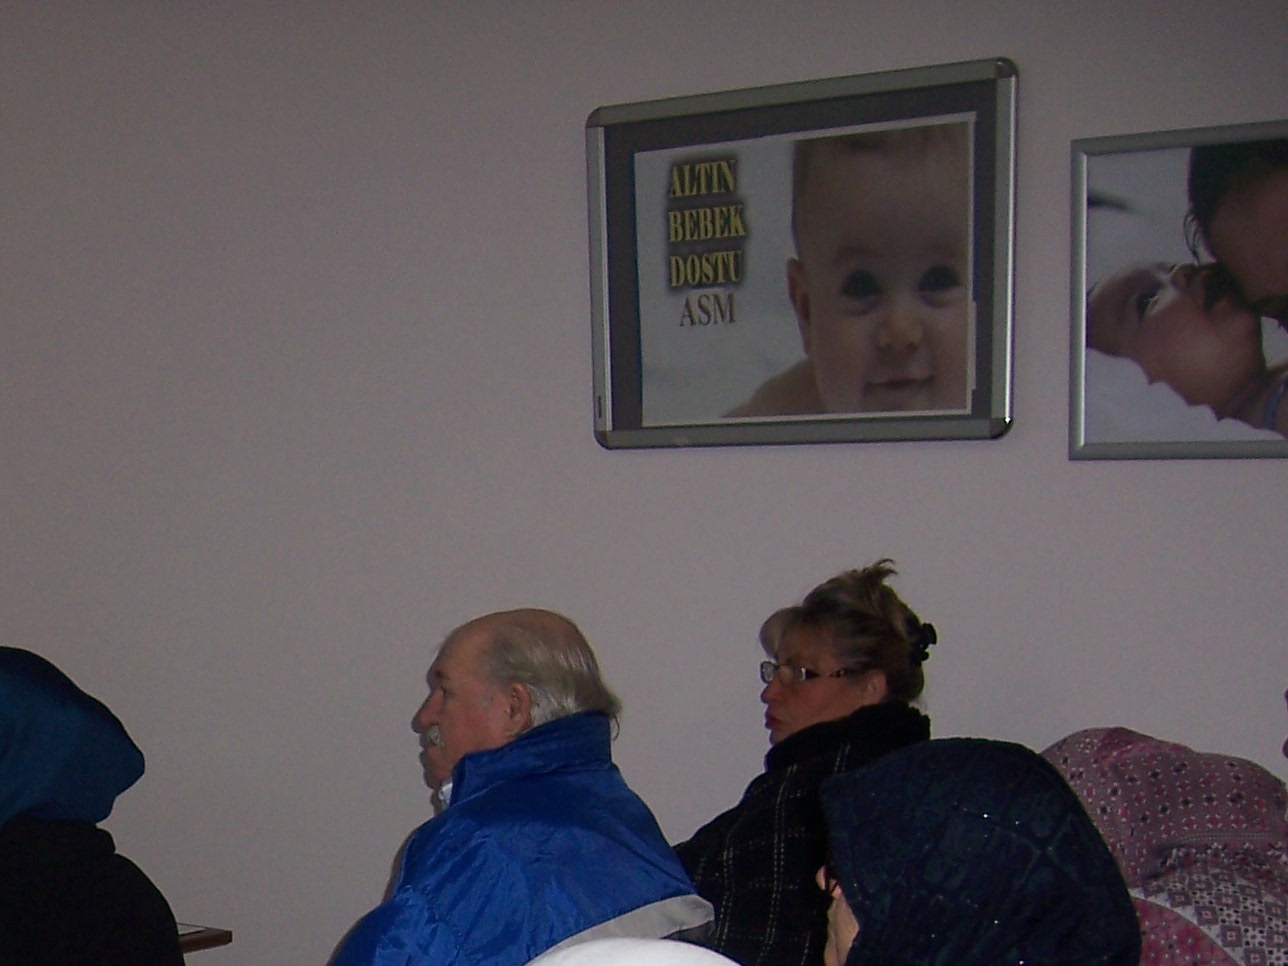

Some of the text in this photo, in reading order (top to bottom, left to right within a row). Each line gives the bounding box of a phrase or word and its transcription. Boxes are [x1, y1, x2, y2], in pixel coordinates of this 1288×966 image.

[669, 159, 737, 197] ALTIN
[668, 204, 746, 242] BEBEK
[670, 250, 743, 287] DOSTU
[679, 293, 737, 327] ASM
